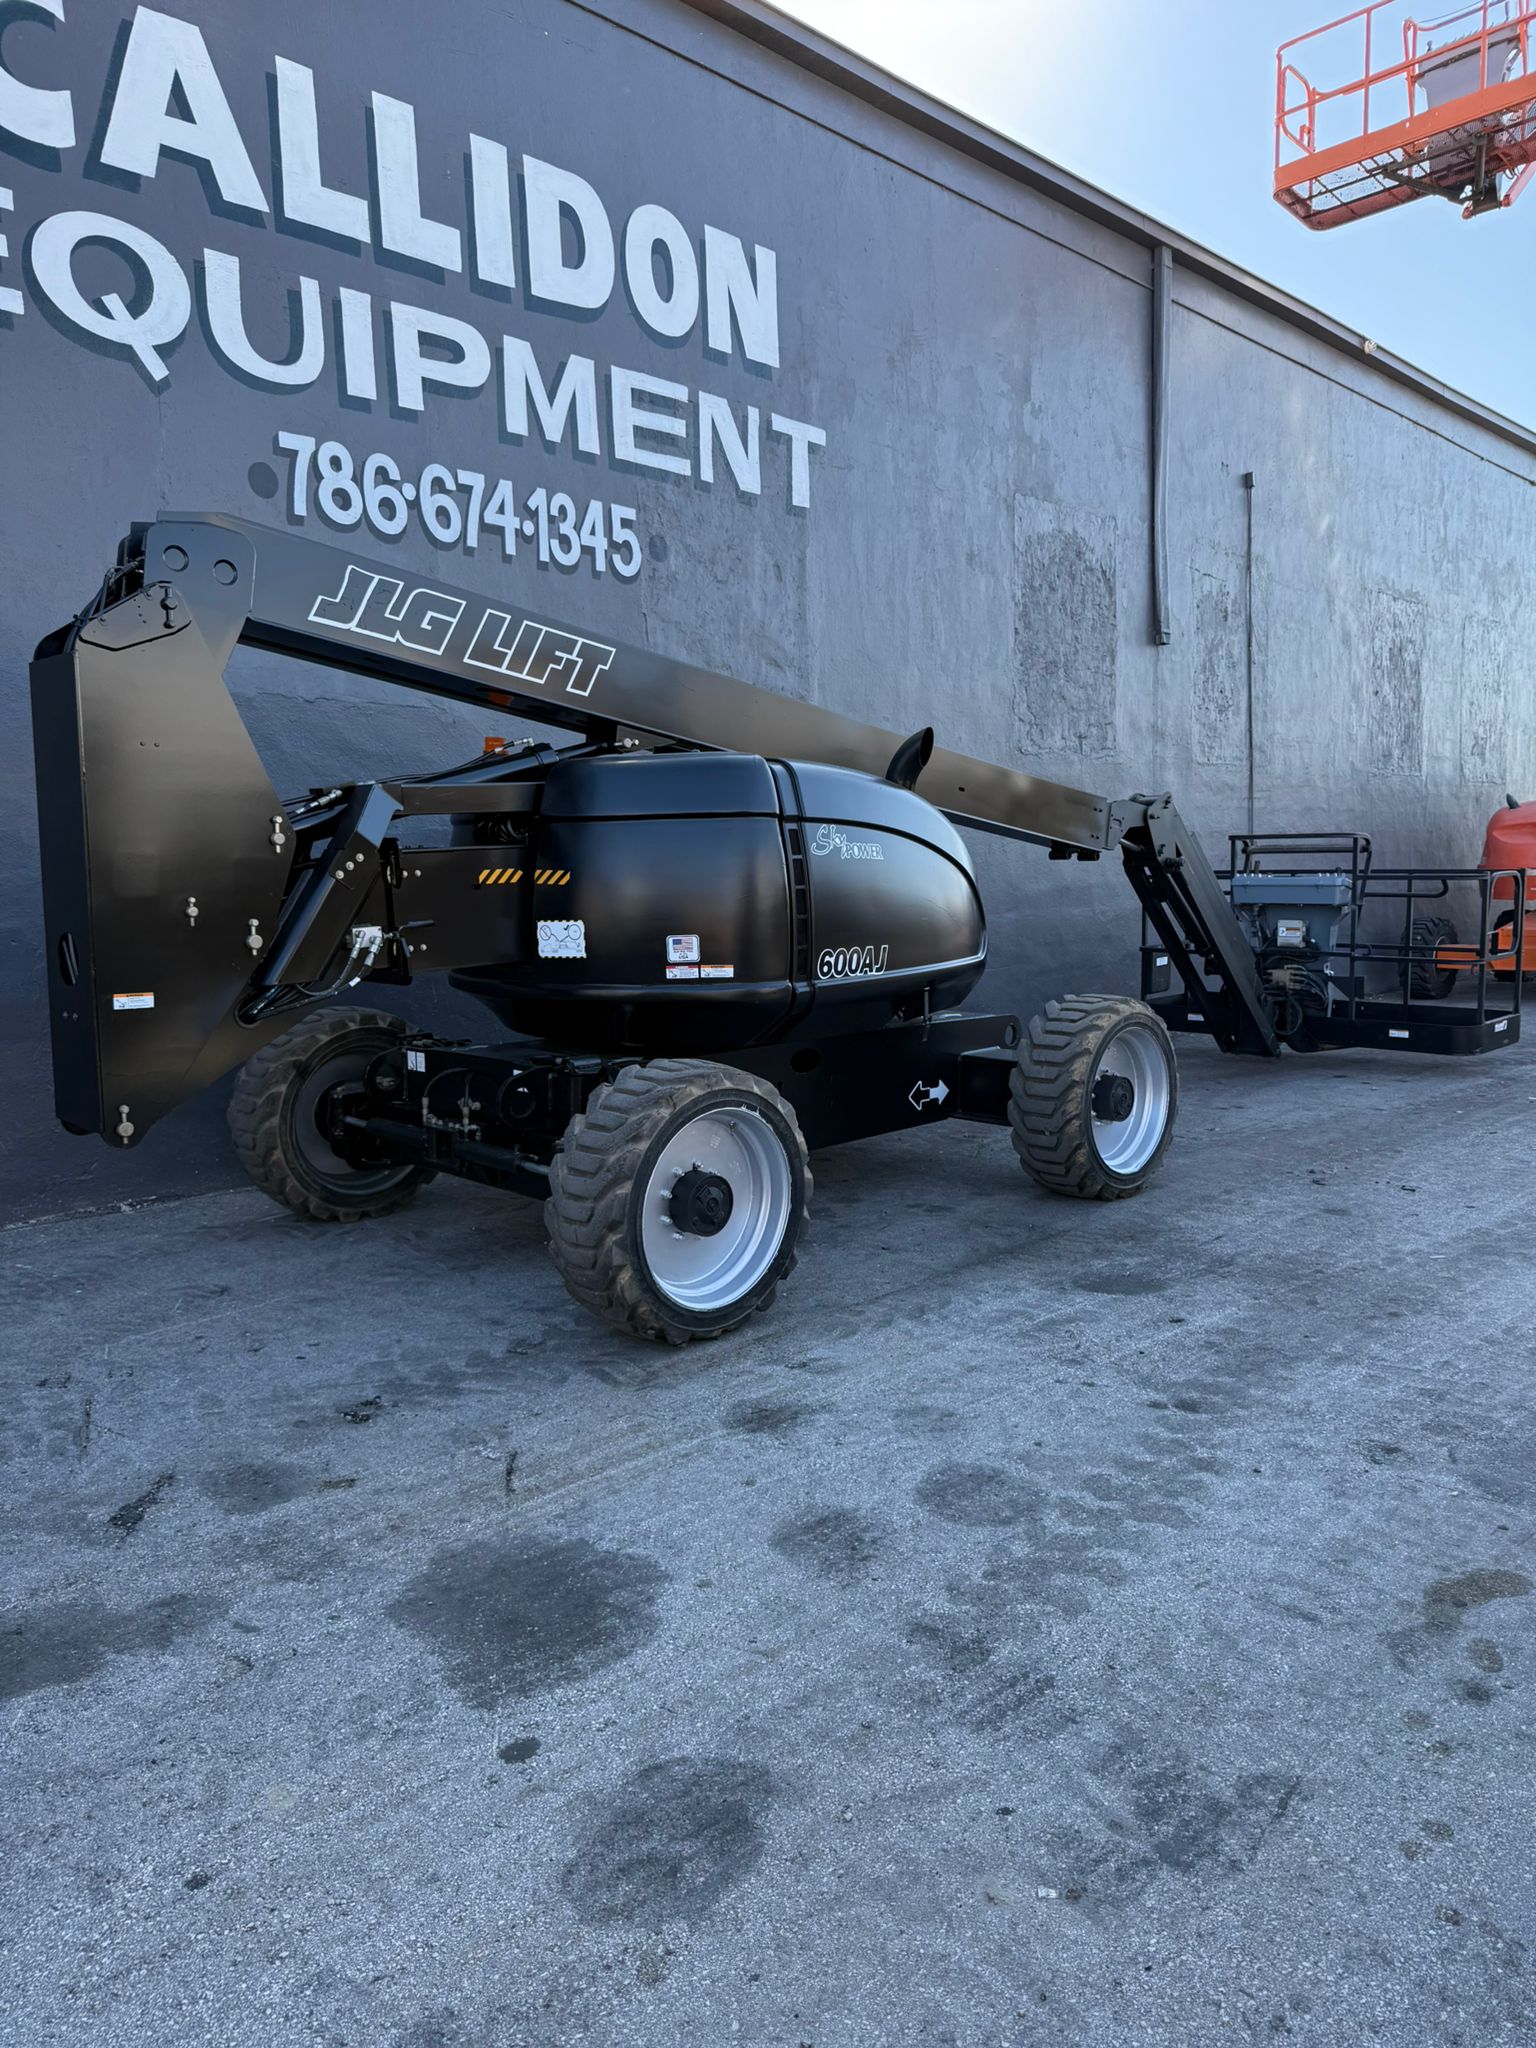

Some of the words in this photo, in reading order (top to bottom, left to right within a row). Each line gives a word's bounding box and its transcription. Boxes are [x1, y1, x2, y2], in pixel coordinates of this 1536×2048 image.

[0, 186, 826, 508] QUIPMENT
[308, 565, 467, 655] JLG
[463, 608, 616, 696] LIFT
[817, 945, 888, 979] 600AJ
